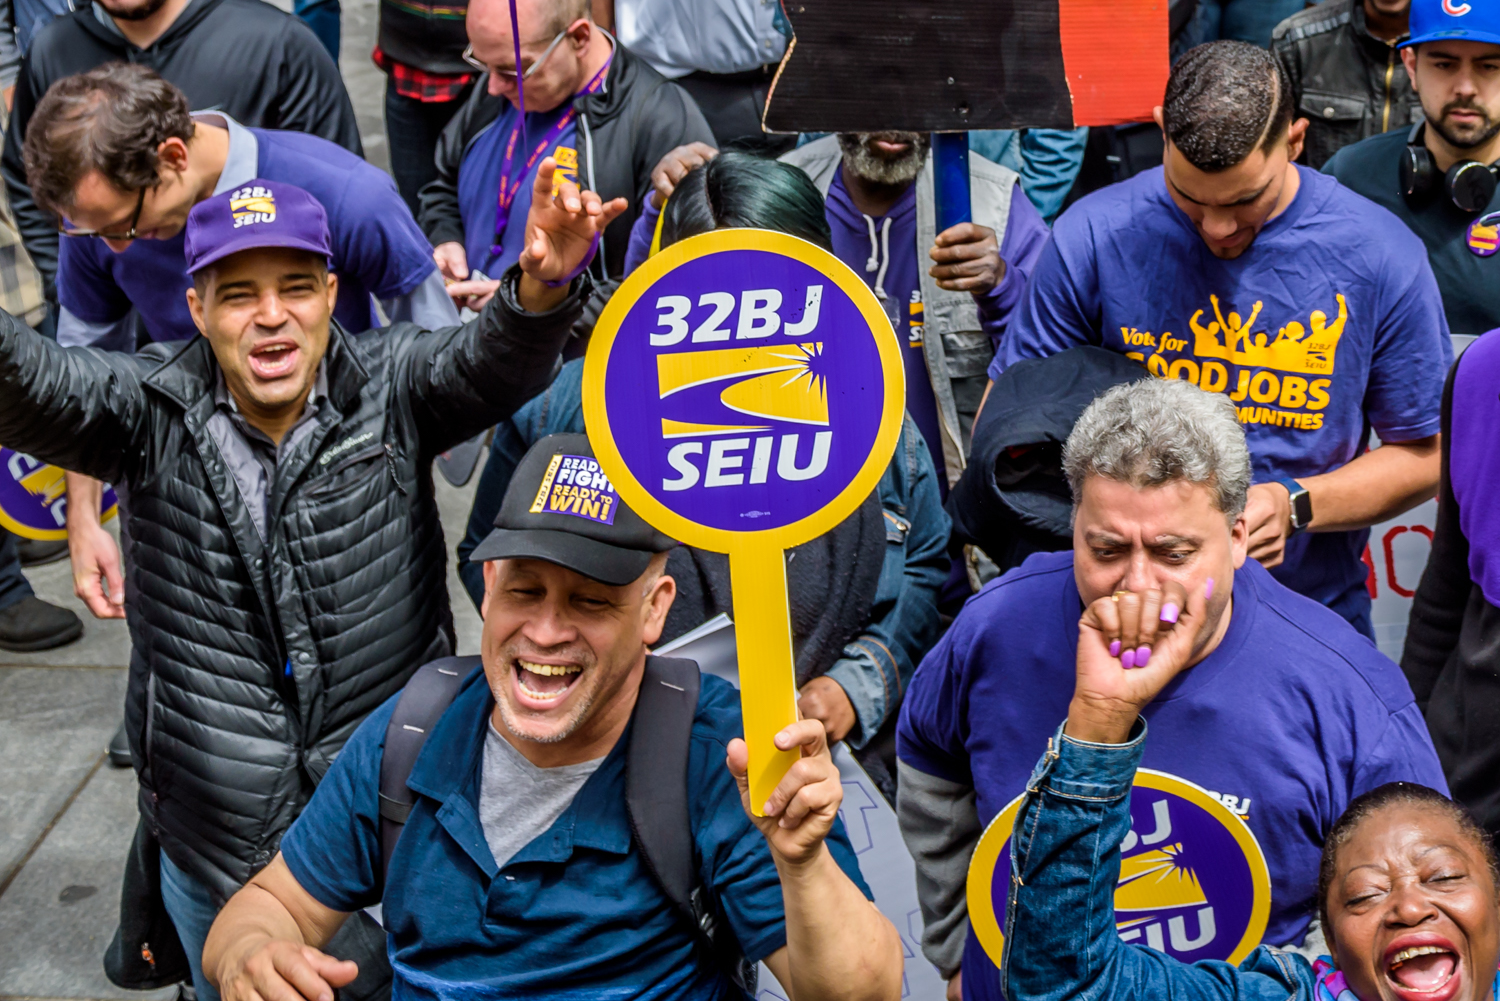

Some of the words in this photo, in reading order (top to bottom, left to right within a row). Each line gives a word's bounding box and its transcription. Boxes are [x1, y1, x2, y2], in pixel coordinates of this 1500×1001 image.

[229, 186, 274, 203] 32BJ
[233, 212, 276, 229] SEIU
[650, 285, 823, 346] 32BJ
[1157, 332, 1188, 353] for
[1304, 359, 1327, 369] SEIU
[1230, 369, 1332, 411] JOBS
[562, 458, 604, 474] READ
[662, 431, 833, 491] SEIU
[553, 484, 600, 501] READY
[600, 495, 613, 504] TO
[550, 494, 610, 521] WIN!
